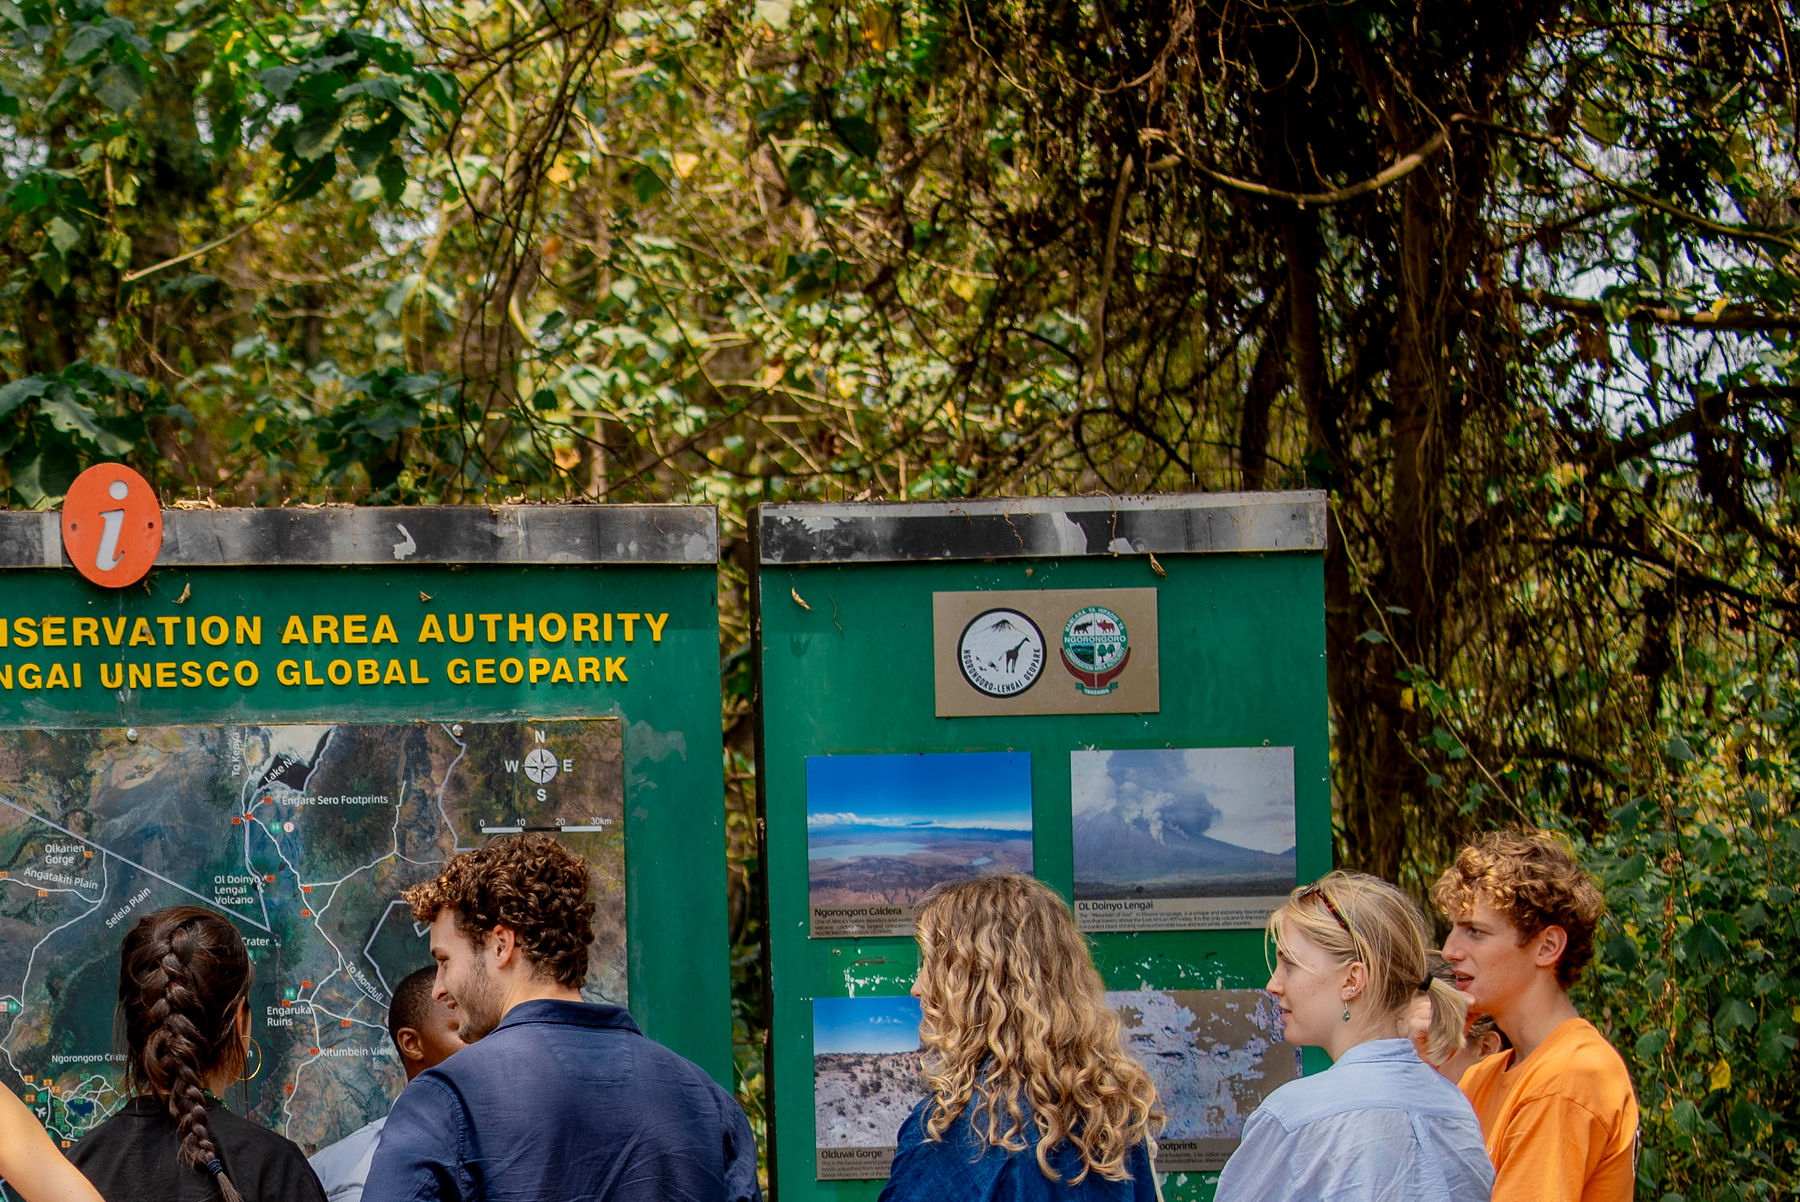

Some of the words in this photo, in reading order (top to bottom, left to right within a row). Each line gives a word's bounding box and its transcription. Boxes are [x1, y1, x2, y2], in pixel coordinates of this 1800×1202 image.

[282, 614, 399, 645] AREA
[418, 612, 669, 643] AUTHORITY
[1064, 635, 1126, 643] NGORONGORO
[1023, 647, 1041, 681] GEOPARK
[100, 660, 259, 689] UNESCO
[277, 657, 429, 686] GLOBAL
[447, 656, 629, 685] GEOPARK
[535, 731, 545, 743] N
[505, 760, 519, 773] W
[563, 760, 573, 772] E
[264, 766, 285, 784] Lake
[282, 795, 314, 807] Engare
[317, 796, 338, 805] Sero
[341, 794, 388, 806] Footprints
[536, 789, 547, 801] S
[479, 819, 485, 827] 0
[516, 818, 526, 826] 10
[556, 817, 566, 826] 20
[591, 817, 612, 825] 30km
[45, 843, 85, 854] Olkarien
[45, 854, 75, 866] Gorge
[24, 867, 72, 885] Angatakiti
[74, 877, 98, 890] Plain
[215, 886, 247, 896] Lengai
[214, 896, 253, 905] Volcano
[1092, 901, 1122, 911] Doinyo
[1124, 900, 1153, 911] Lengai
[106, 904, 131, 929] Selela
[128, 887, 151, 909] Plain
[814, 908, 867, 918] Ngorongoro
[869, 906, 902, 916] Caldera
[346, 961, 358, 974] To
[355, 970, 384, 1001] Monduli
[267, 1006, 312, 1017] Engaruka
[267, 1017, 293, 1027] Ruins
[52, 1054, 103, 1064] Ngorongoro
[1159, 1141, 1197, 1151] ootprints
[821, 1149, 854, 1159] Olduvai
[856, 1149, 882, 1159] Gorge
